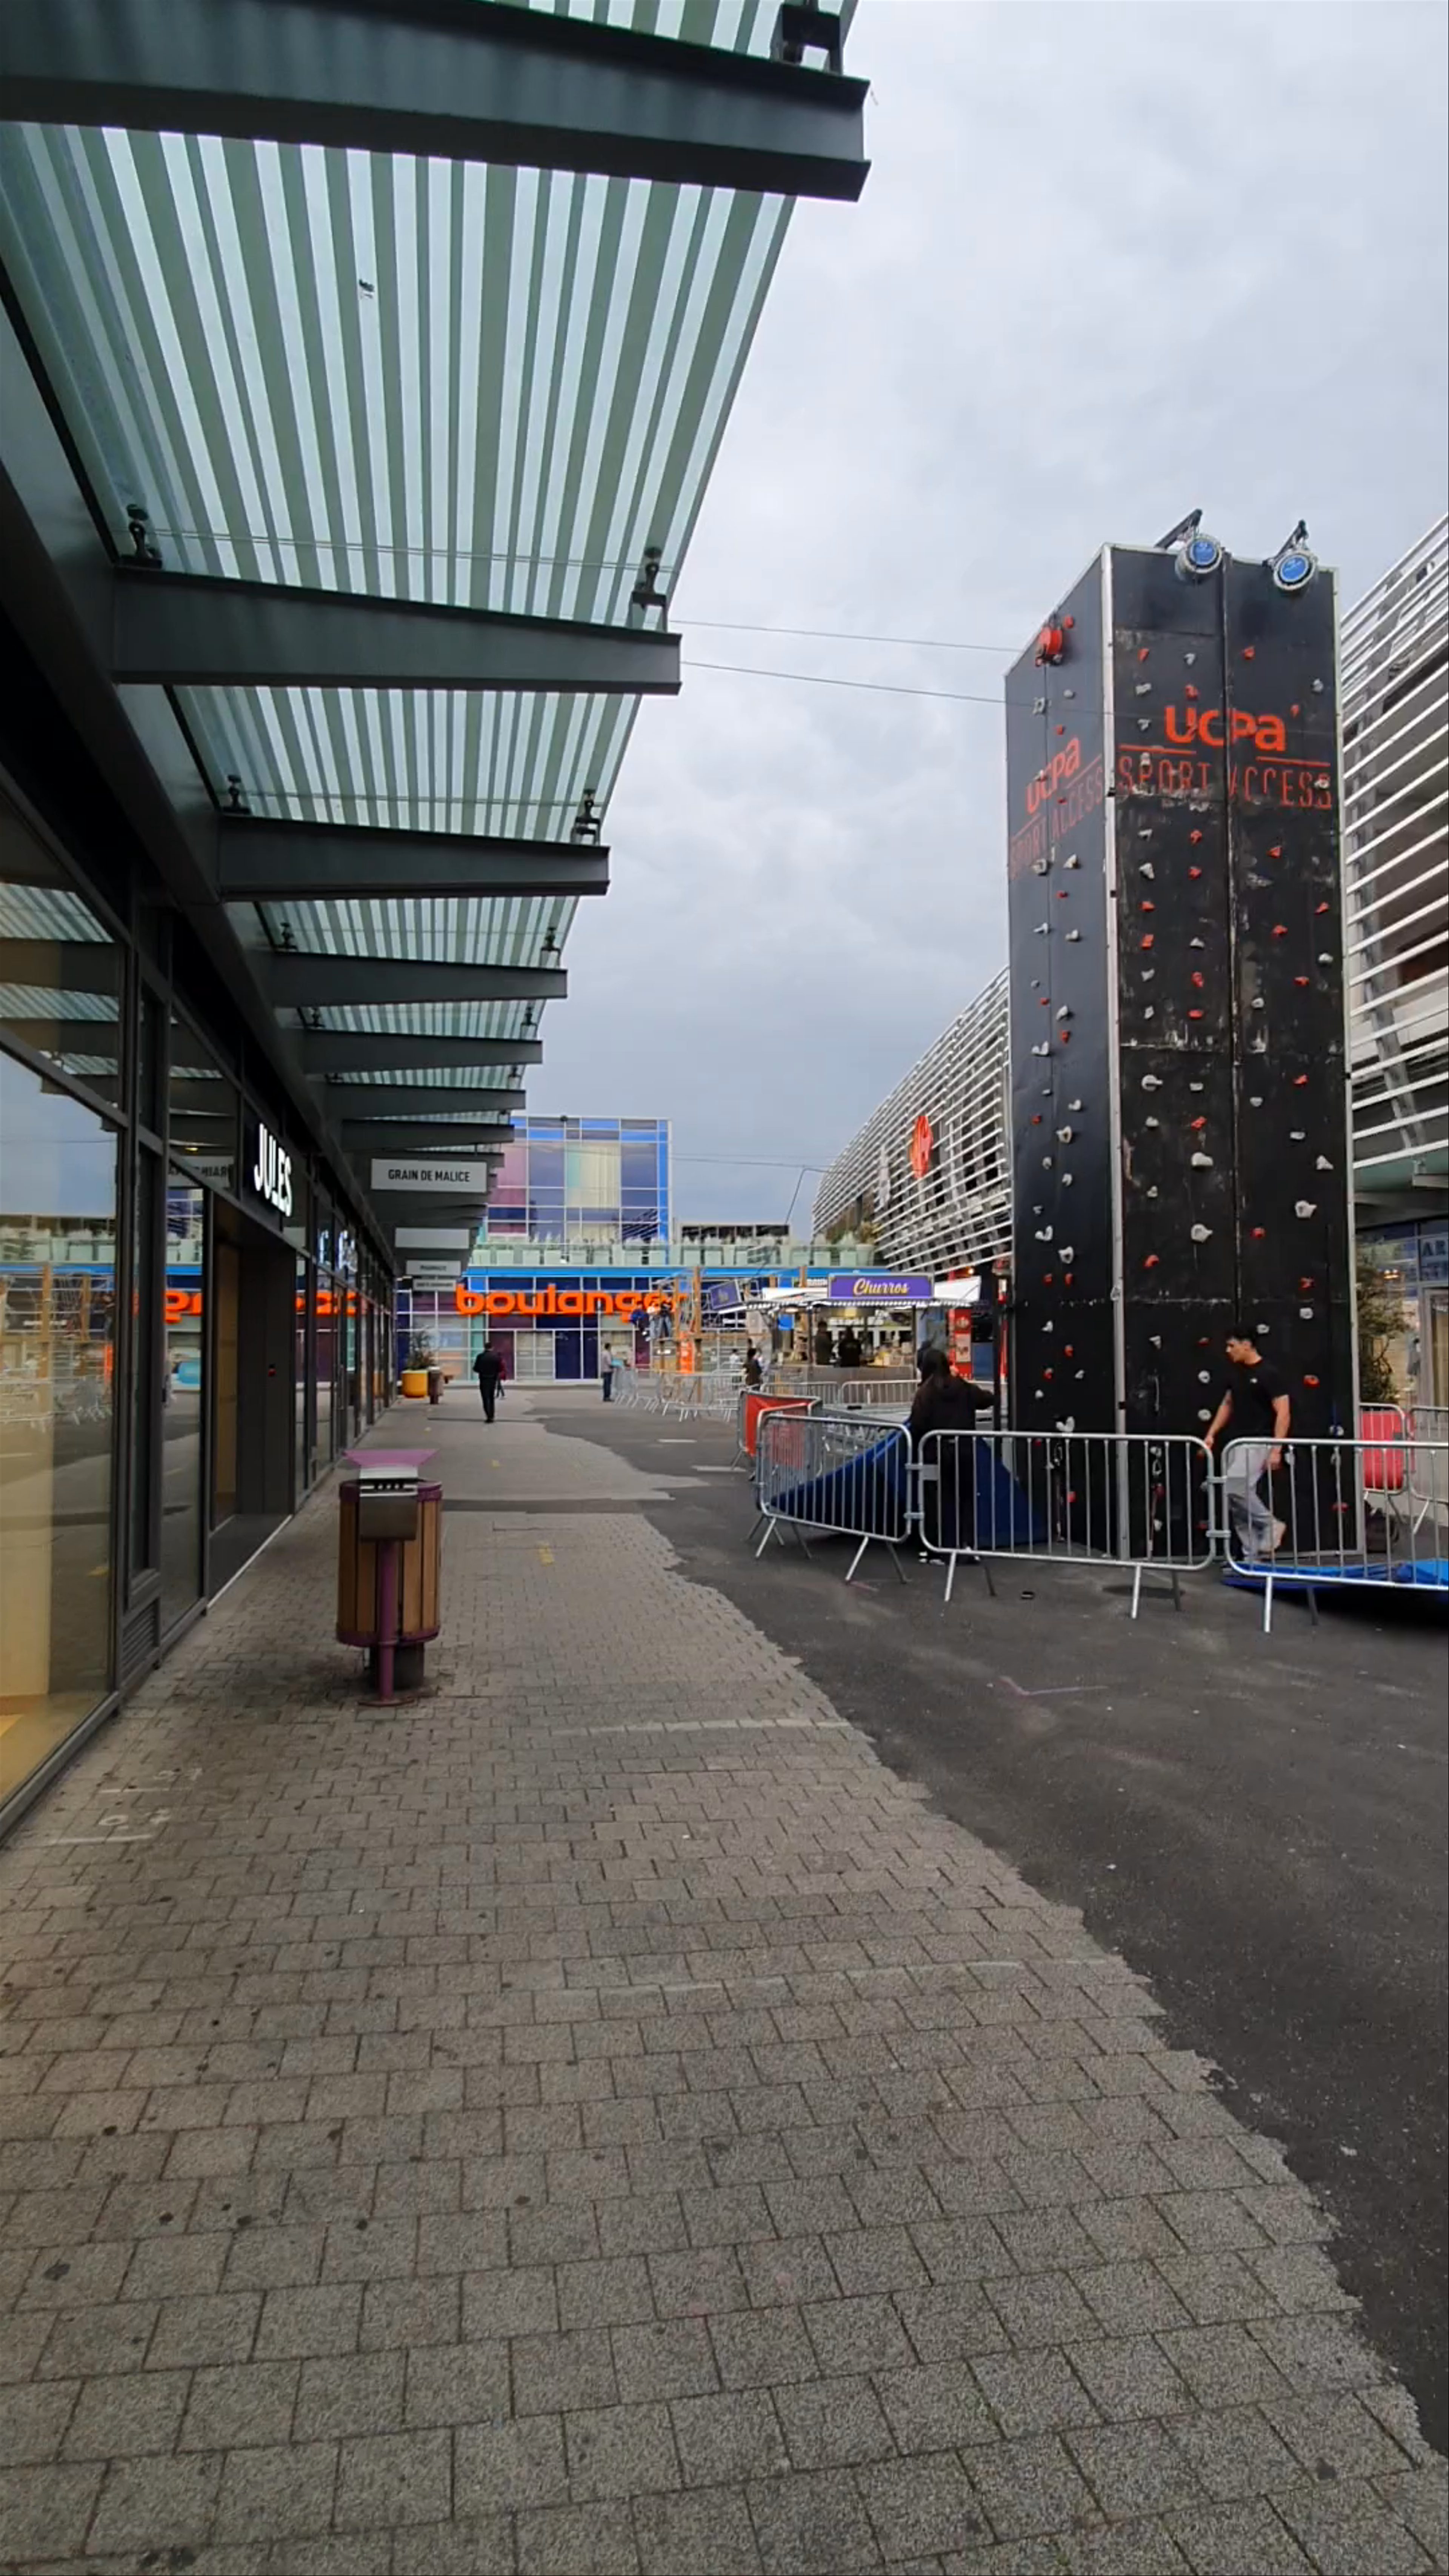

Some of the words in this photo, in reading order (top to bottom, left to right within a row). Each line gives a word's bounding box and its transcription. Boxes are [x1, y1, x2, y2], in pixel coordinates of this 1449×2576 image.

[254, 1123, 292, 1217] JULES
[388, 1169, 418, 1180] GRAIN
[420, 1170, 433, 1181] DE
[435, 1170, 470, 1182] MALICE
[853, 1278, 910, 1296] Churros
